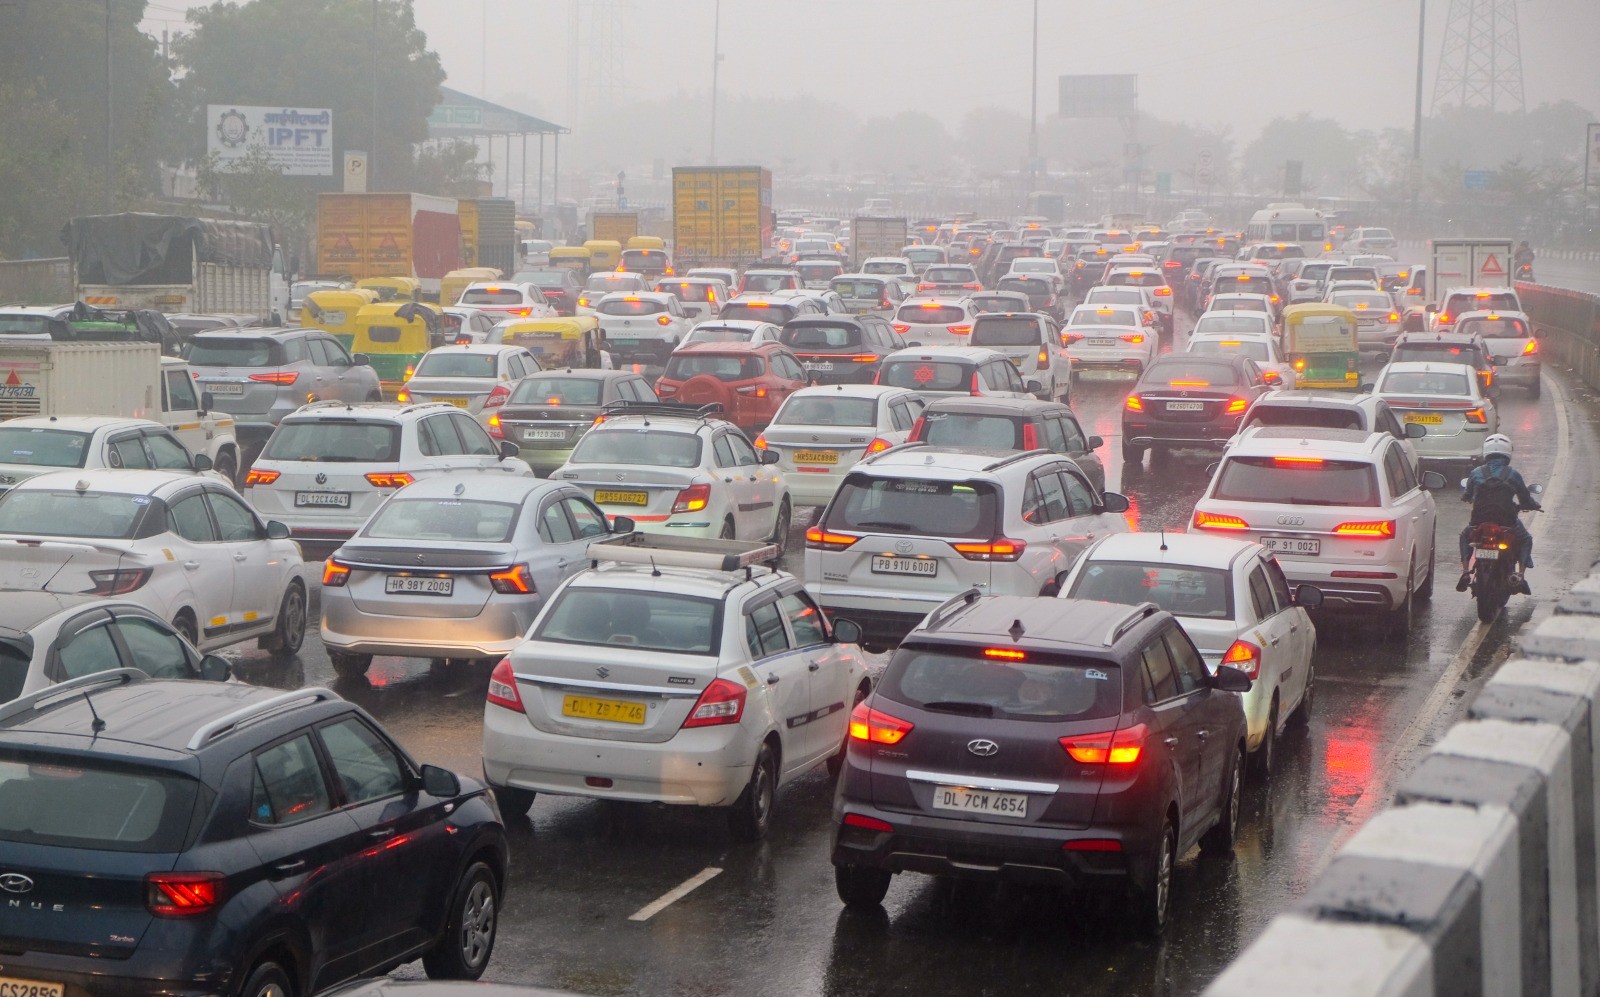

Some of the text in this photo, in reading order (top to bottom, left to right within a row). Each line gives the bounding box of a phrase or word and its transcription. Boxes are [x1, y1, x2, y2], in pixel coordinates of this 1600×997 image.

[268, 127, 328, 146] IPFT
[301, 494, 348, 504] DL12CX4841
[1266, 541, 1319, 551] HP 91 0021
[878, 559, 935, 573] PB 91U 6008
[392, 579, 450, 592] HR 98Y 2009
[943, 792, 1025, 813] DL 7CM 4654
